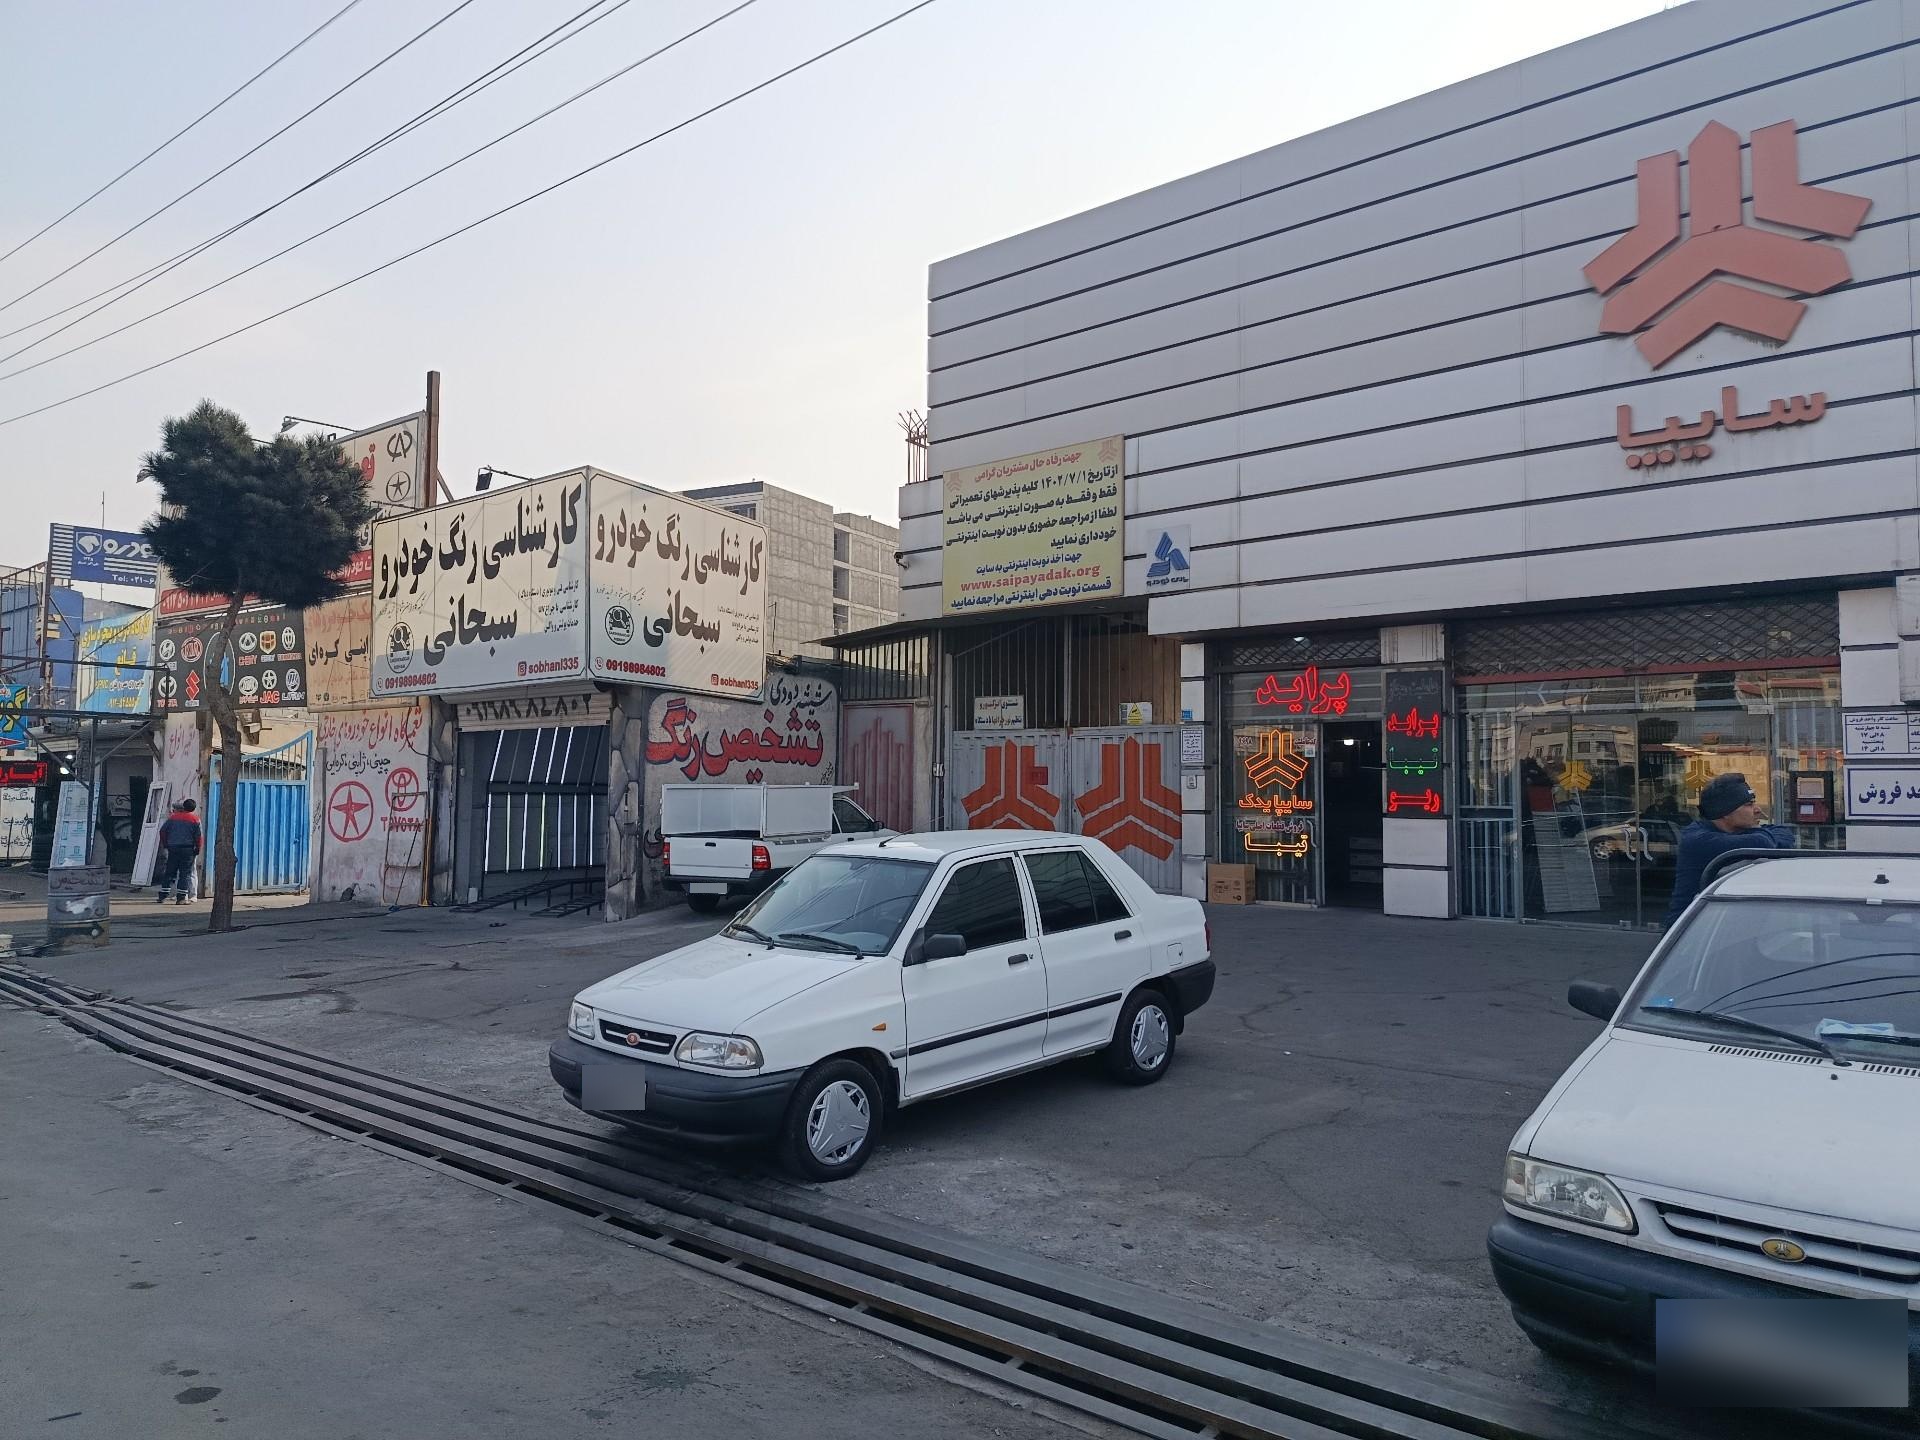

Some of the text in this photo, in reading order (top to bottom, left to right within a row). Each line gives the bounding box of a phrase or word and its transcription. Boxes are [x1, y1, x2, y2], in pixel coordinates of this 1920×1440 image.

[1617, 385, 1825, 470] سایپا
[1030, 459, 1045, 471] حال
[1046, 456, 1062, 467] رفاه
[1063, 452, 1082, 464] جهت
[997, 461, 1029, 478] مشتریان
[1021, 480, 1038, 495] کلیه
[1099, 483, 1118, 499] فقط
[949, 492, 983, 509] تعمیراتی
[1024, 500, 1055, 514] صورت
[1055, 498, 1065, 509] به
[985, 504, 1023, 521] اینترنتی
[1058, 512, 1091, 528] مراجعه
[1099, 506, 1118, 519] لطفا
[981, 526, 1007, 541] نوبت
[1007, 523, 1027, 537] بدون
[1027, 517, 1058, 533] حضوری
[379, 483, 583, 600] کارشناسی رنگ خودرو
[945, 528, 981, 547] اینترنتی
[1050, 535, 1078, 550] نمایید
[103, 538, 155, 558] ودرو
[594, 503, 763, 596] کارشناسی رنگ خودرو
[1002, 558, 1032, 573] اینترنتی
[1031, 556, 1050, 569] نوبت
[1064, 551, 1082, 564] جهت
[112, 574, 129, 584] Tel:
[960, 565, 1102, 592] www.saipayadak.org
[976, 564, 995, 577] سایت
[1059, 582, 1082, 596] نوبت
[1082, 576, 1112, 593] قسمت
[975, 593, 1005, 608] مراجعه
[1005, 588, 1039, 605] اینترنتی
[643, 587, 721, 655] سبحانی
[423, 593, 518, 667] سبحانی
[260, 690, 280, 704] JAC
[769, 677, 833, 716] شیشه دودی
[1255, 664, 1352, 716] پراید
[369, 710, 393, 750] انواع
[1387, 707, 1441, 738] پراید
[645, 698, 825, 785] تشخیص رنگ
[1387, 788, 1442, 813] ریو
[1858, 781, 1902, 805] فروش
[1238, 793, 1314, 817] سایپا یدک
[1244, 831, 1309, 858] تیبا
